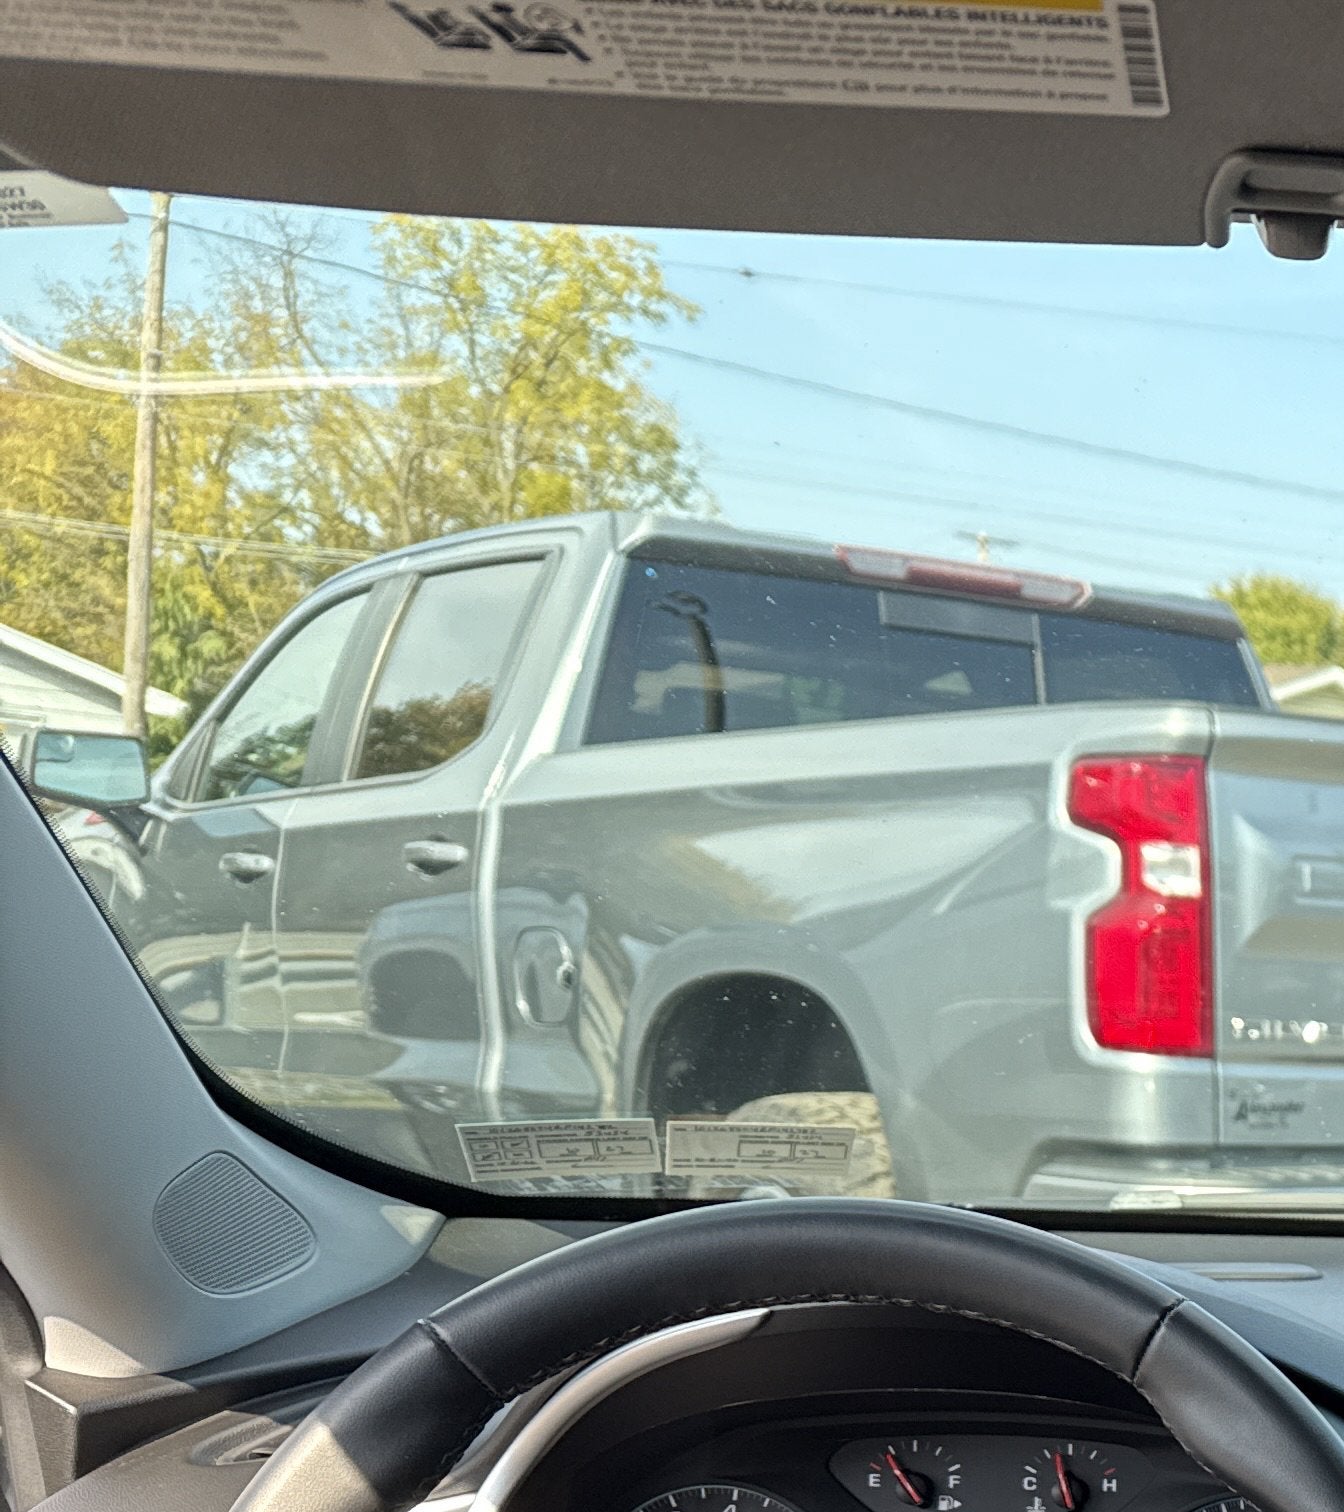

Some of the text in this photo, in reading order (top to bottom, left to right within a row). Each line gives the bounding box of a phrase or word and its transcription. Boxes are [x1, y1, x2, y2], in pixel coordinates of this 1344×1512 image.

[967, 11, 1109, 29] INTELLIGENTS
[868, 1473, 880, 1487] E
[949, 1475, 961, 1489] F
[1022, 1476, 1037, 1491] C
[1102, 1478, 1117, 1492] H
